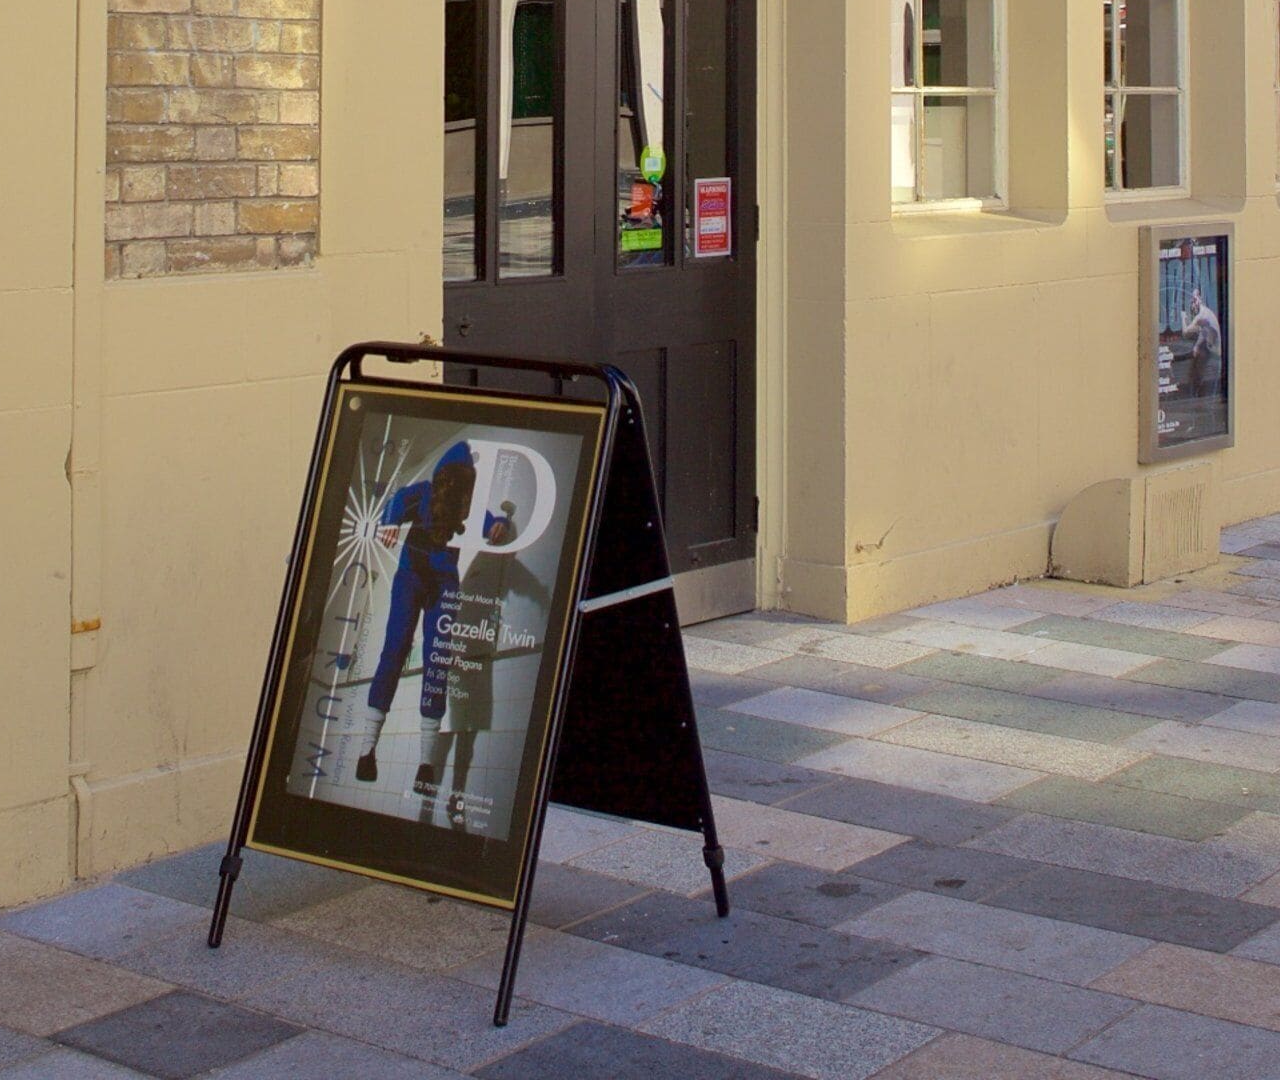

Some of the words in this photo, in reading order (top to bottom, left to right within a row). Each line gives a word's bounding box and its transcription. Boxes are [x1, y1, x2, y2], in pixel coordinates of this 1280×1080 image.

[436, 614, 496, 642] Gazelle
[501, 624, 536, 648] Twin
[432, 636, 467, 653] Bernholz
[429, 651, 454, 666] Great
[453, 656, 483, 671] Pagans
